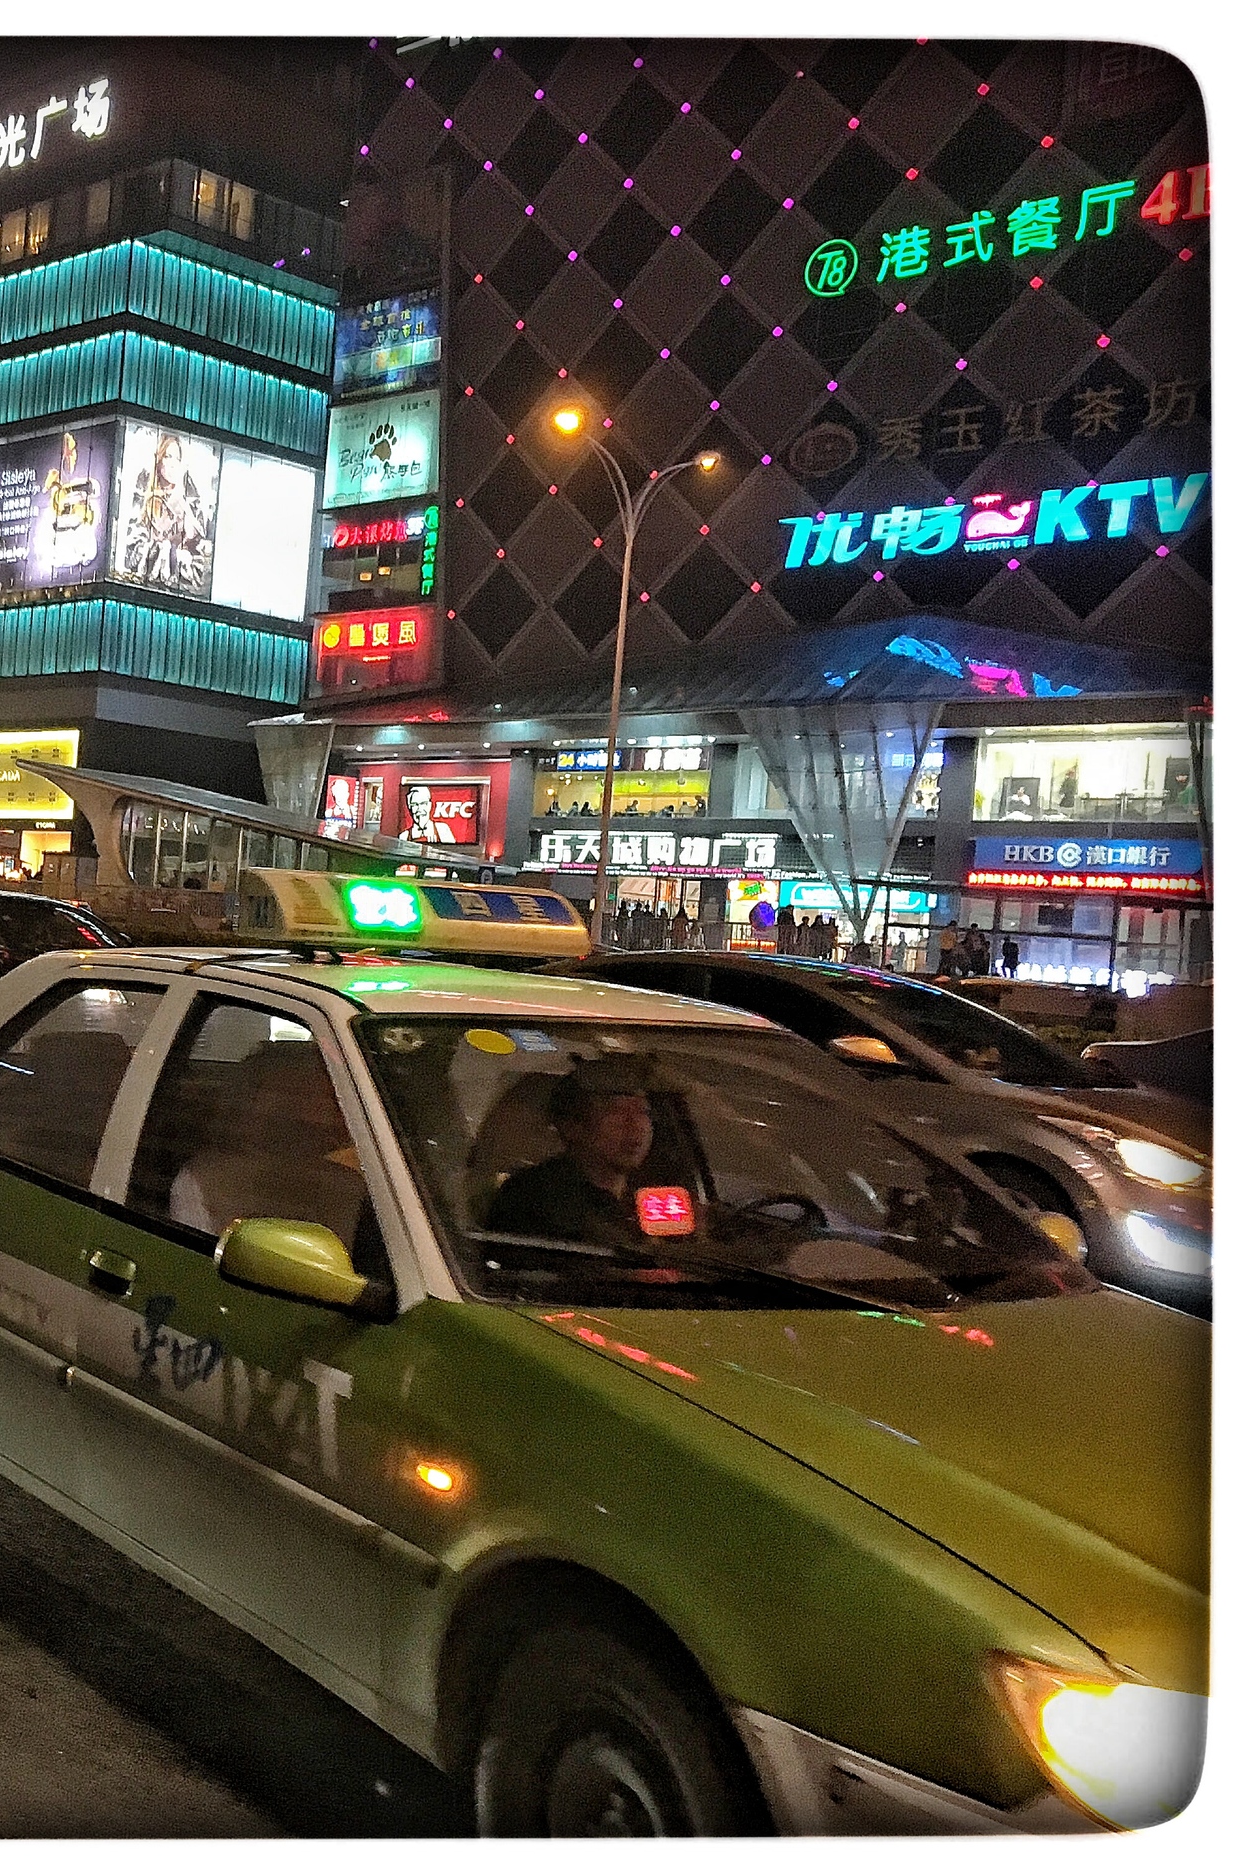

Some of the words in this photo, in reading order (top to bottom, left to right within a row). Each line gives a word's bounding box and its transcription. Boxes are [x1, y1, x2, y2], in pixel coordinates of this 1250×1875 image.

[876, 180, 1136, 283] 港式餐厅
[877, 377, 1199, 461] 秀玉红茶坊
[1034, 473, 1209, 546] KTV
[433, 801, 476, 818] KFC
[540, 833, 777, 868] 乐天城购物广场
[1004, 844, 1054, 863] HKB
[1086, 846, 1171, 866] 漢口銀行
